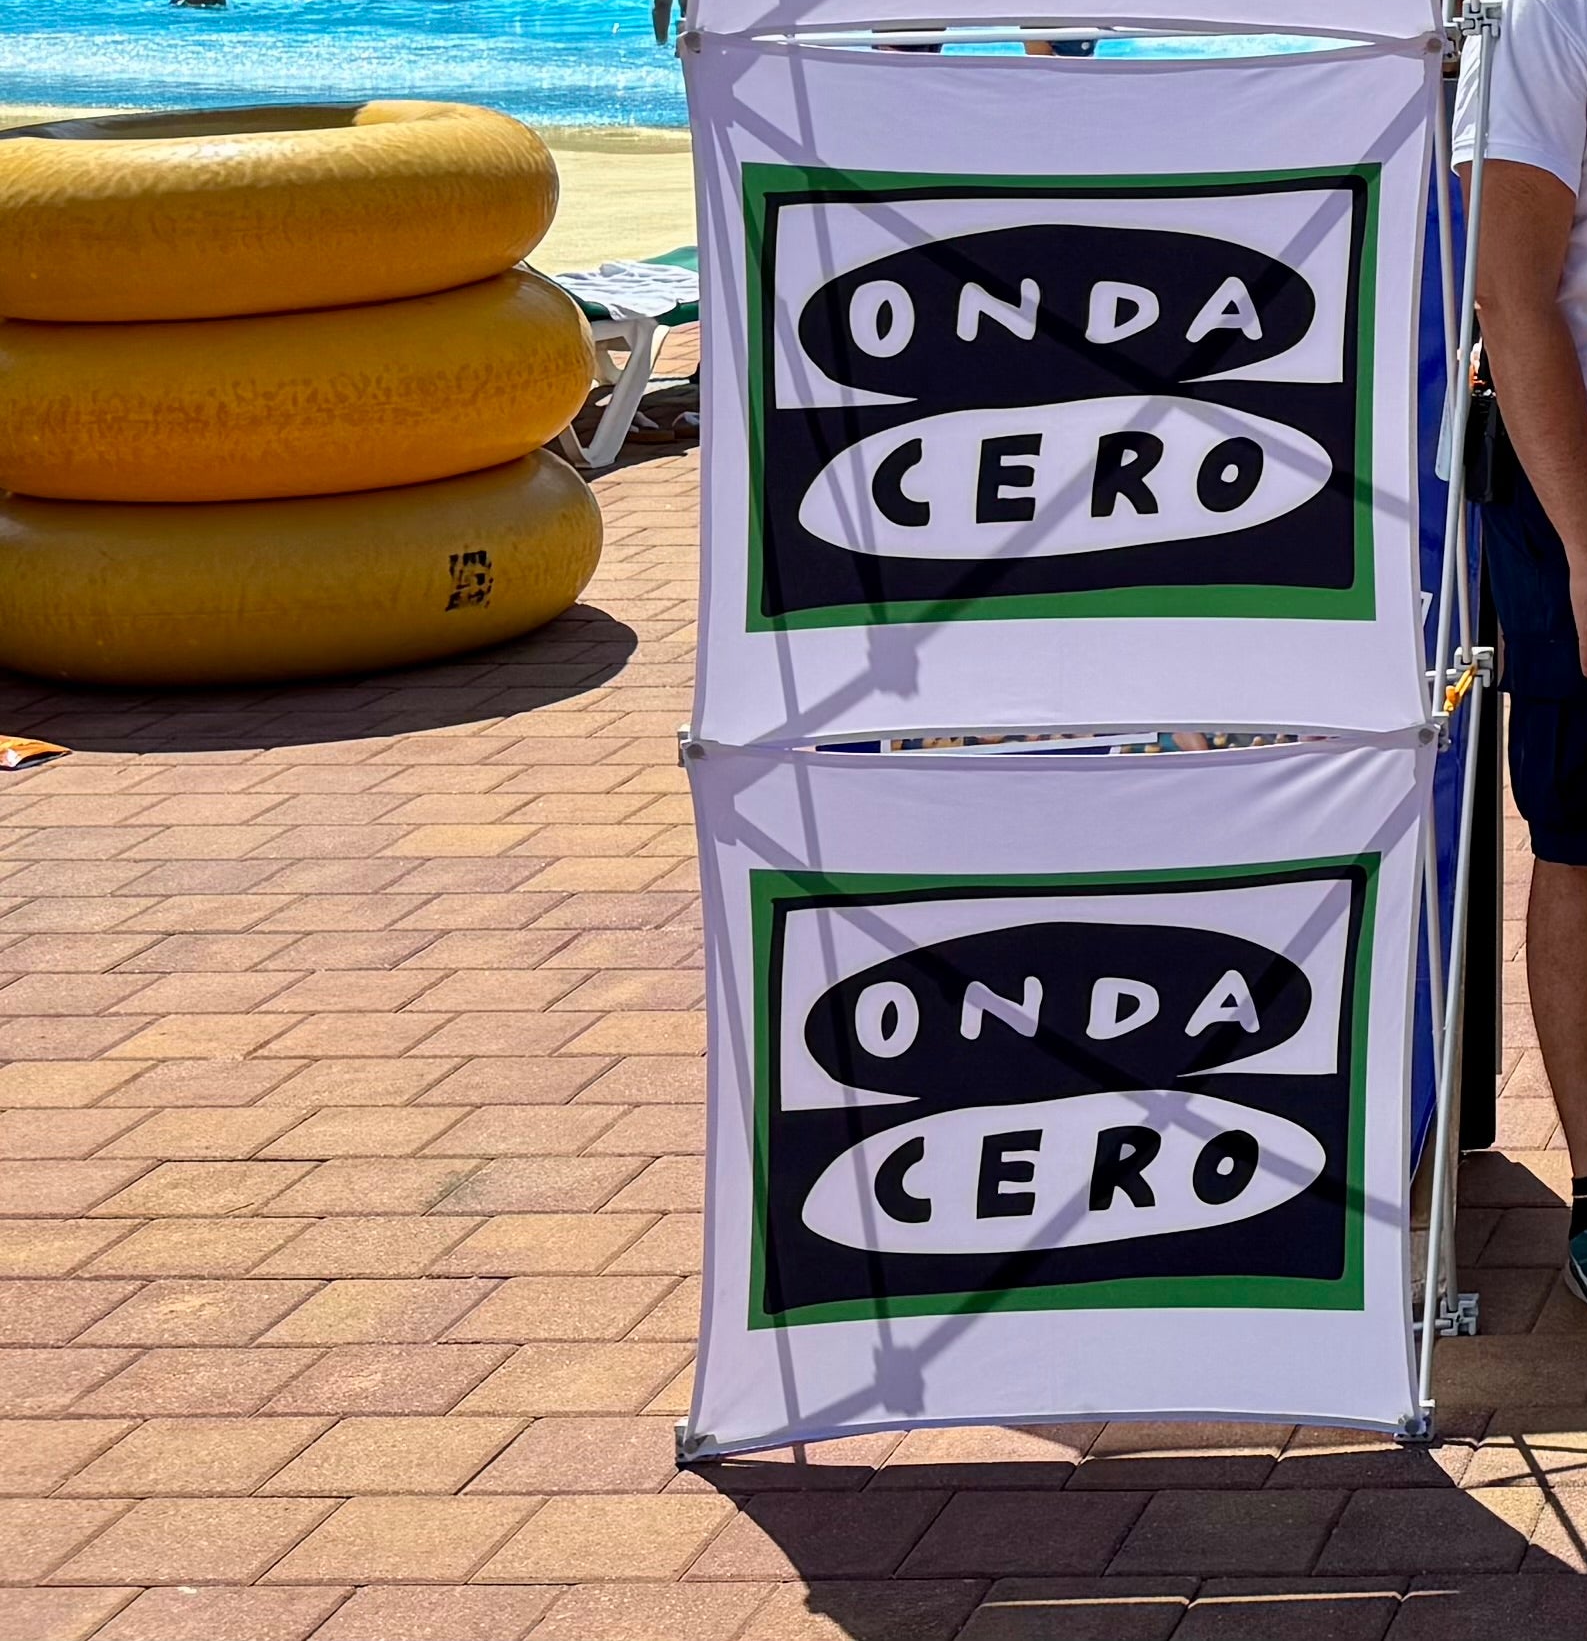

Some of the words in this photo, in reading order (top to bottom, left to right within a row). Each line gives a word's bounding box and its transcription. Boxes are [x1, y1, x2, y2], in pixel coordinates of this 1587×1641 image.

[849, 276, 1263, 359] ONDA
[870, 431, 1265, 528] CERO
[854, 969, 1261, 1059] ONDA
[873, 1124, 1261, 1225] CERO
